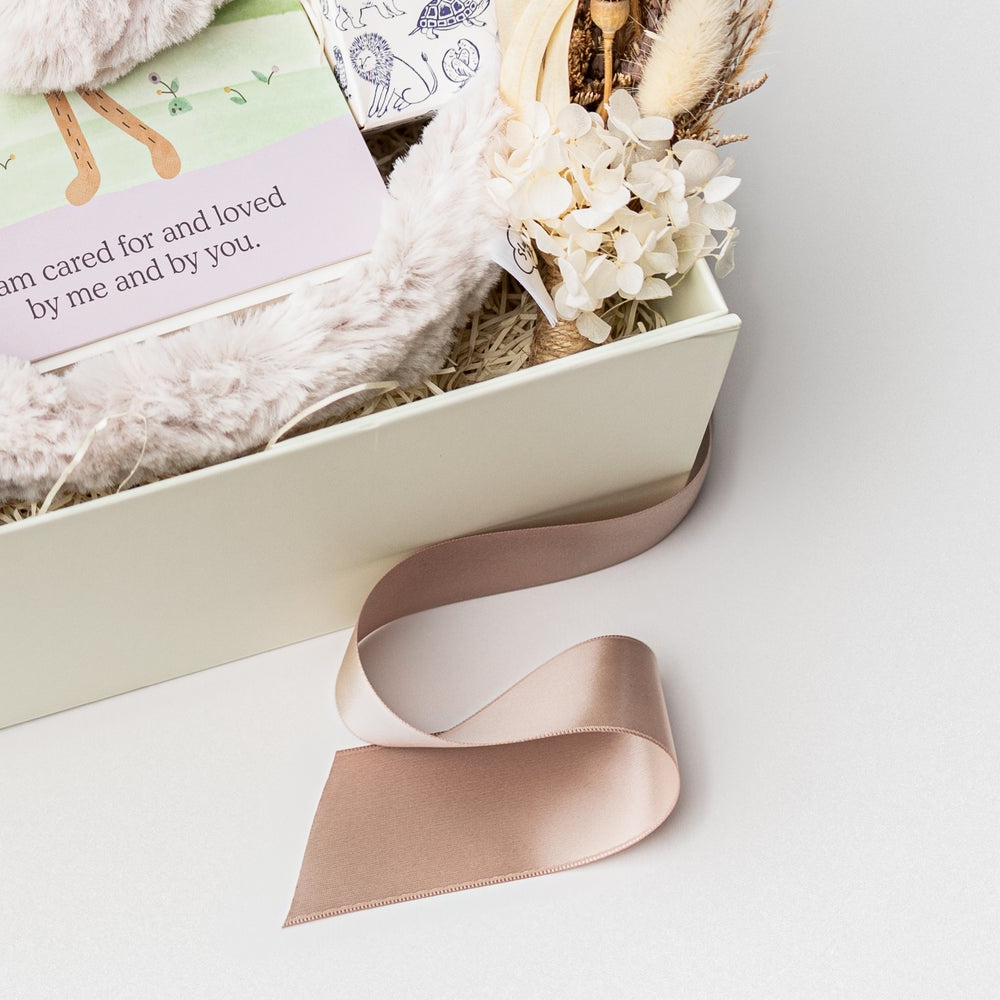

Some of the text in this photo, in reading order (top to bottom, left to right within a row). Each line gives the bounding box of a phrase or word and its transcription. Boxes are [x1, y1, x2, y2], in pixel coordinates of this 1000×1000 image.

[26, 235, 261, 320] by me and by you.
[43, 240, 115, 281] cared
[117, 232, 155, 257] for
[162, 210, 212, 243] and
[212, 185, 287, 226] loved
